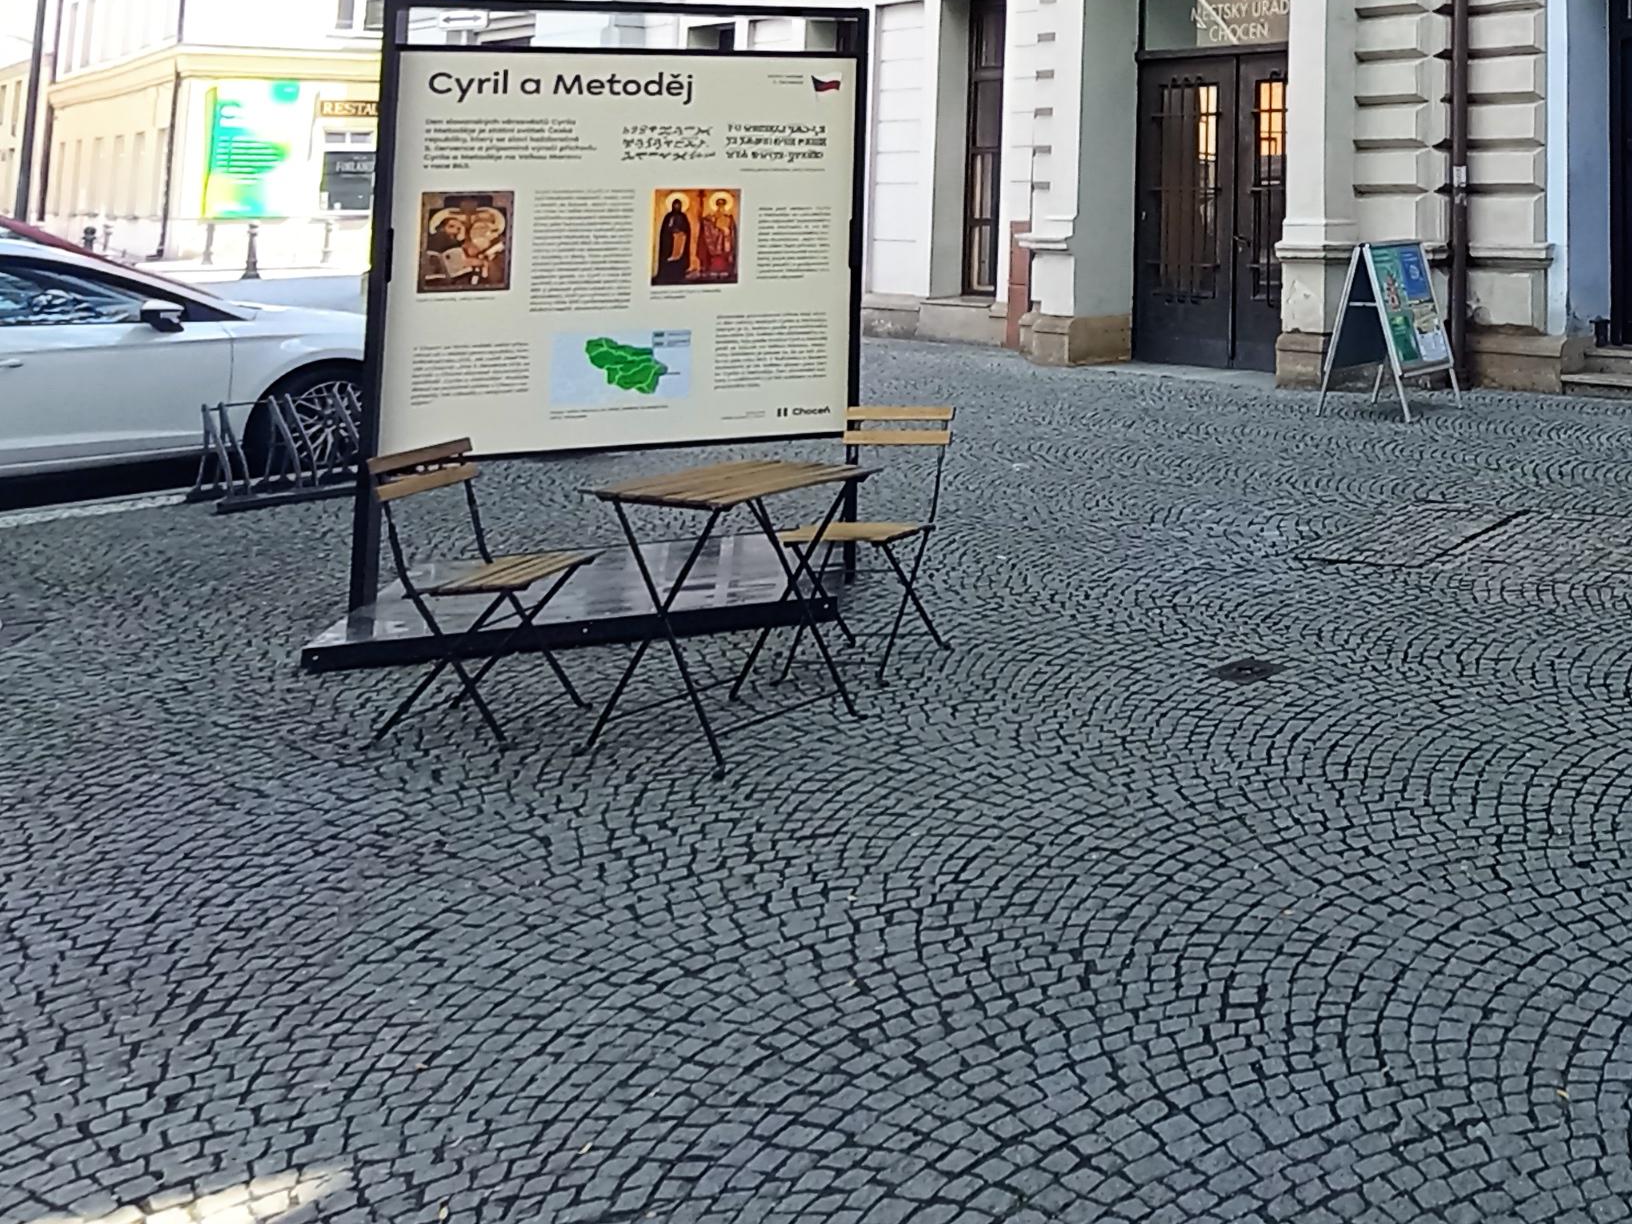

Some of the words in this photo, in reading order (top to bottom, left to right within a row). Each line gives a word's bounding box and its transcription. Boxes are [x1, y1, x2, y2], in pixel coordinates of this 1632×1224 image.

[1208, 18, 1269, 42] CHOCEŇ
[428, 69, 509, 103] Cyril
[520, 78, 541, 95] a
[553, 72, 694, 105] Metoděj
